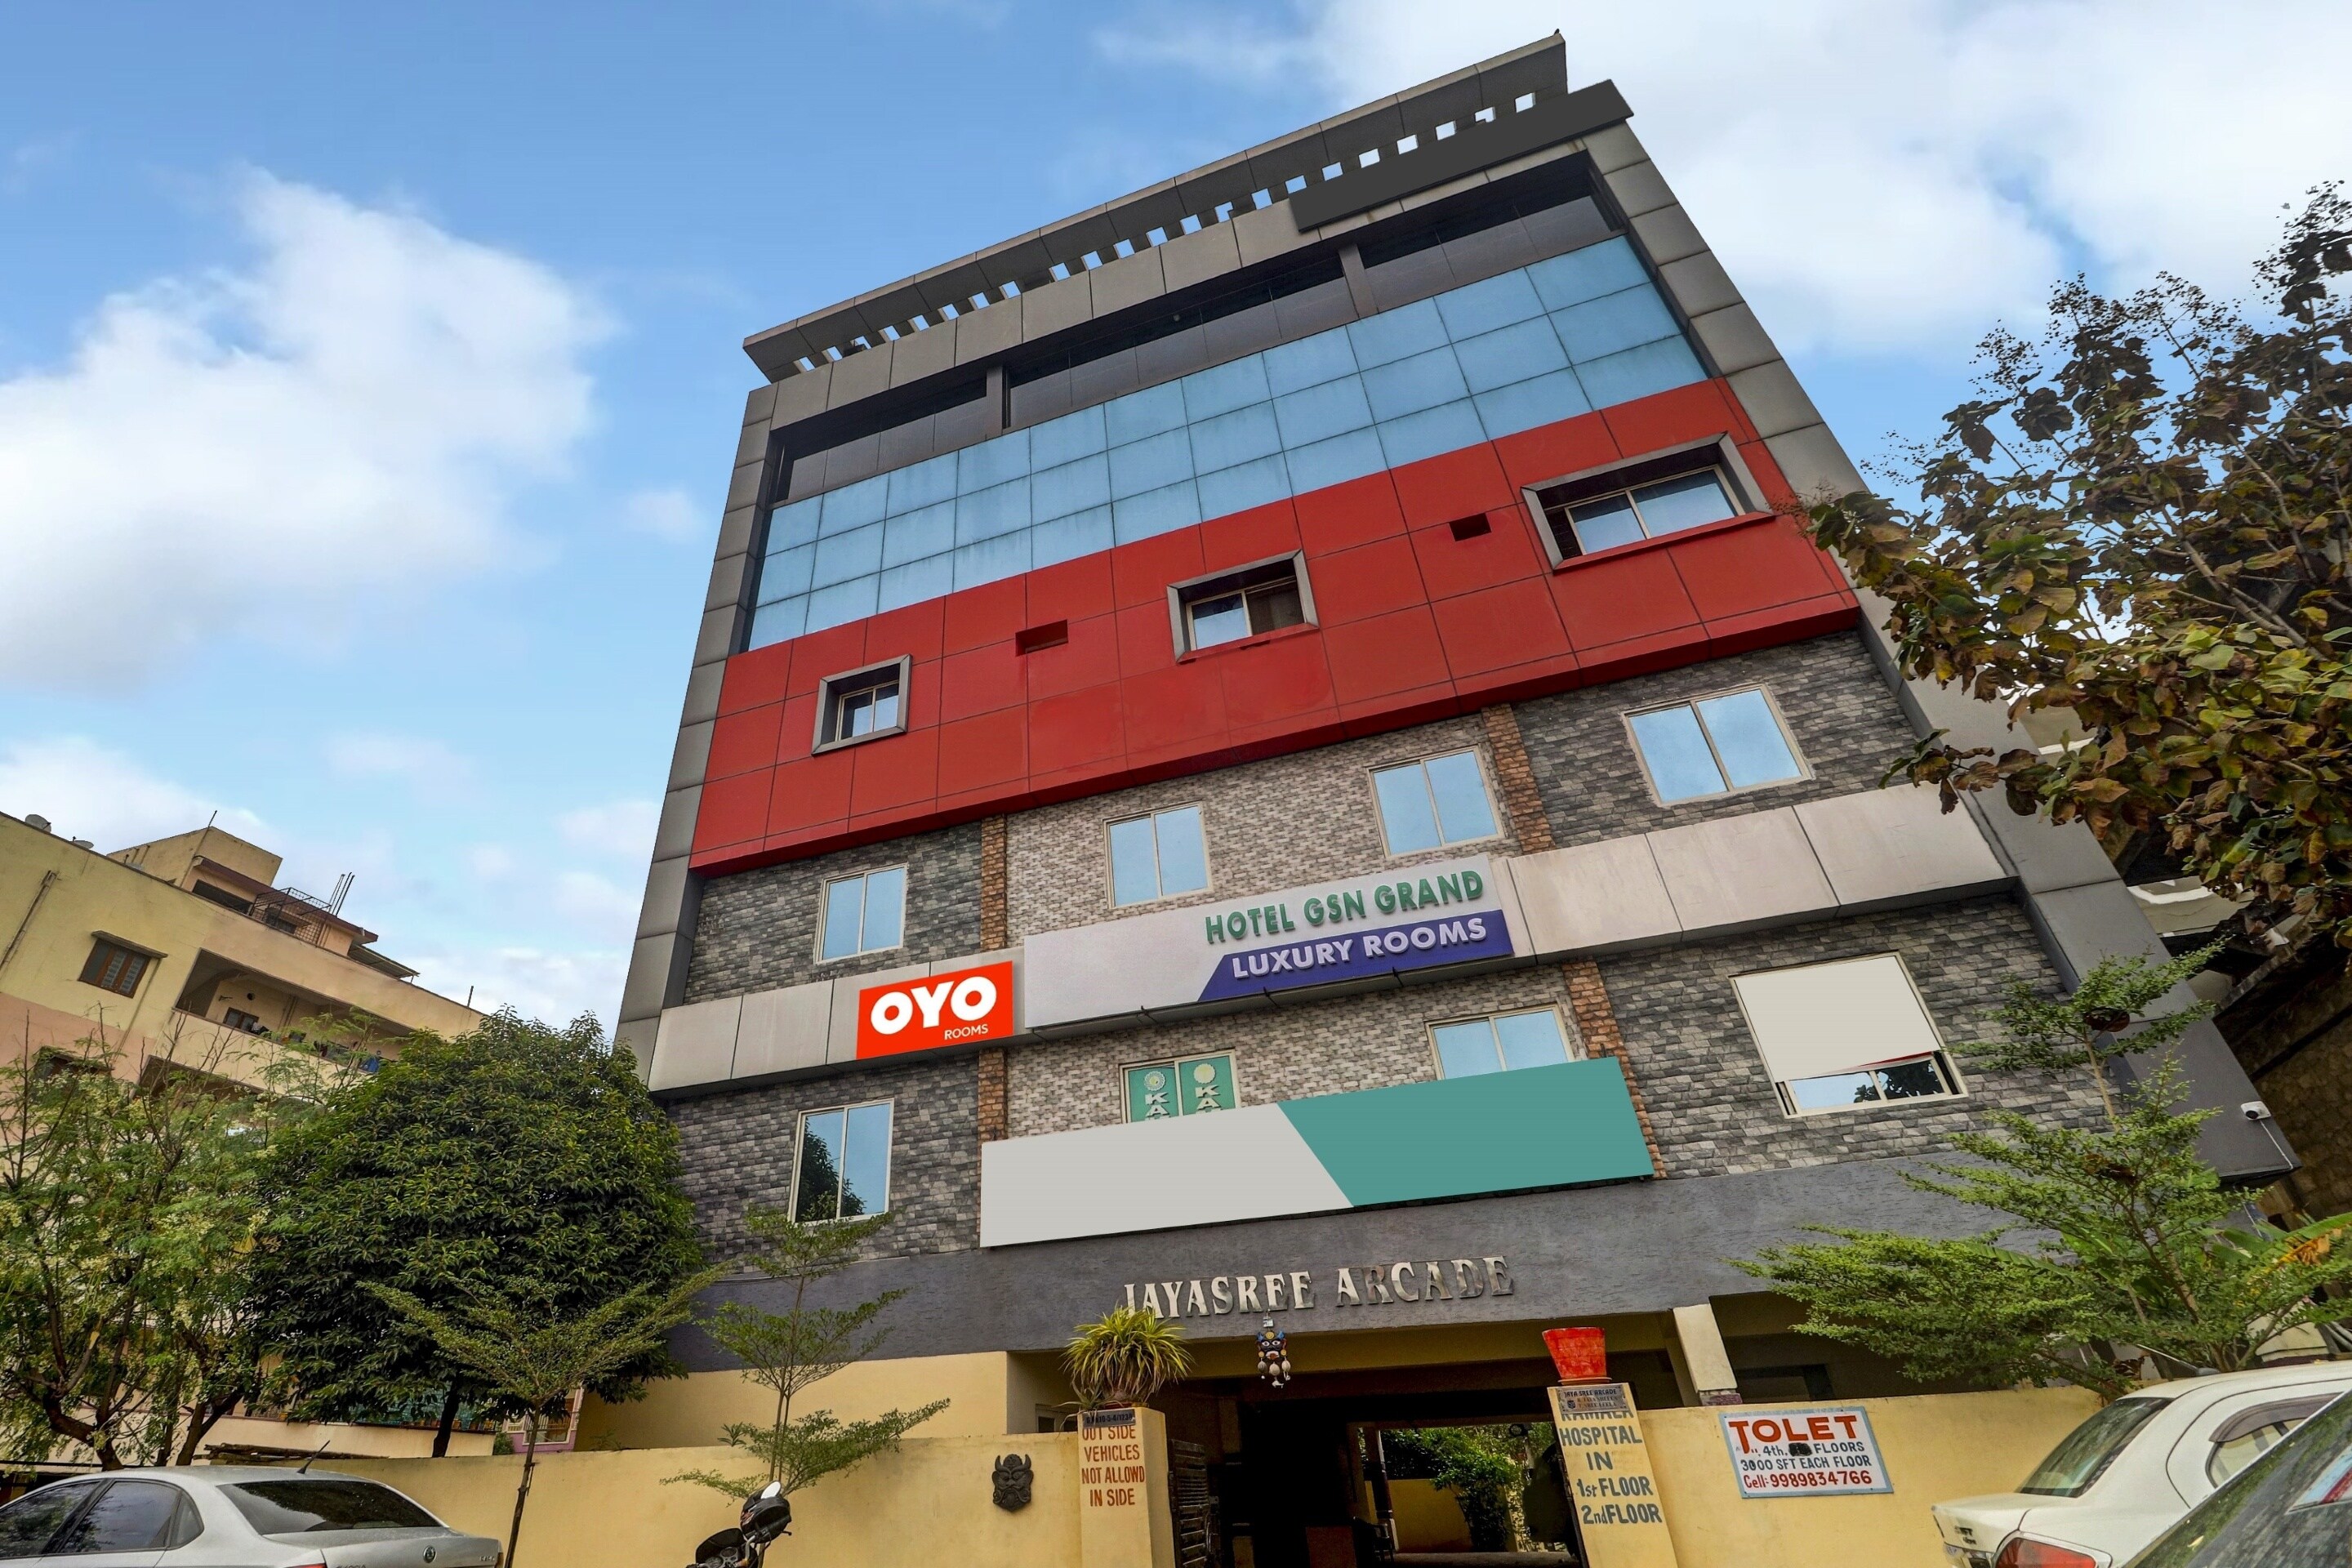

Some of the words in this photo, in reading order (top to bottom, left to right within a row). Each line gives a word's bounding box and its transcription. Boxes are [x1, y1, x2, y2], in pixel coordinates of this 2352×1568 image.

[1205, 902, 1295, 944] HOTEL
[1303, 889, 1366, 925] GSN
[1374, 870, 1483, 913] GRAND
[1232, 938, 1353, 980] LUXURY
[1362, 917, 1487, 959] ROOMS
[871, 976, 997, 1035] OYO
[944, 1023, 989, 1040] ROOMS
[1123, 1270, 1315, 1320] JAYASREE
[1336, 1255, 1515, 1307] ARCADE
[1564, 1390, 1578, 1398] JAYA
[1108, 1425, 1136, 1440] SIDE
[1559, 1425, 1643, 1446] HOSPITAL
[1084, 1444, 1140, 1462] VEHICLES
[1814, 1441, 1865, 1454] FLOORS
[1586, 1450, 1614, 1470] IN
[1776, 1458, 1797, 1470] SFT
[1800, 1456, 1830, 1469] EACH
[1833, 1454, 1872, 1468] FLOOR
[1081, 1467, 1102, 1484] NOT
[1105, 1465, 1145, 1483] ALLOWD
[1770, 1470, 1873, 1487] 9989834766
[1576, 1478, 1597, 1498] 1st
[1598, 1476, 1654, 1497] FLOOR
[1090, 1489, 1102, 1507] IN
[1107, 1488, 1135, 1506] SIDE
